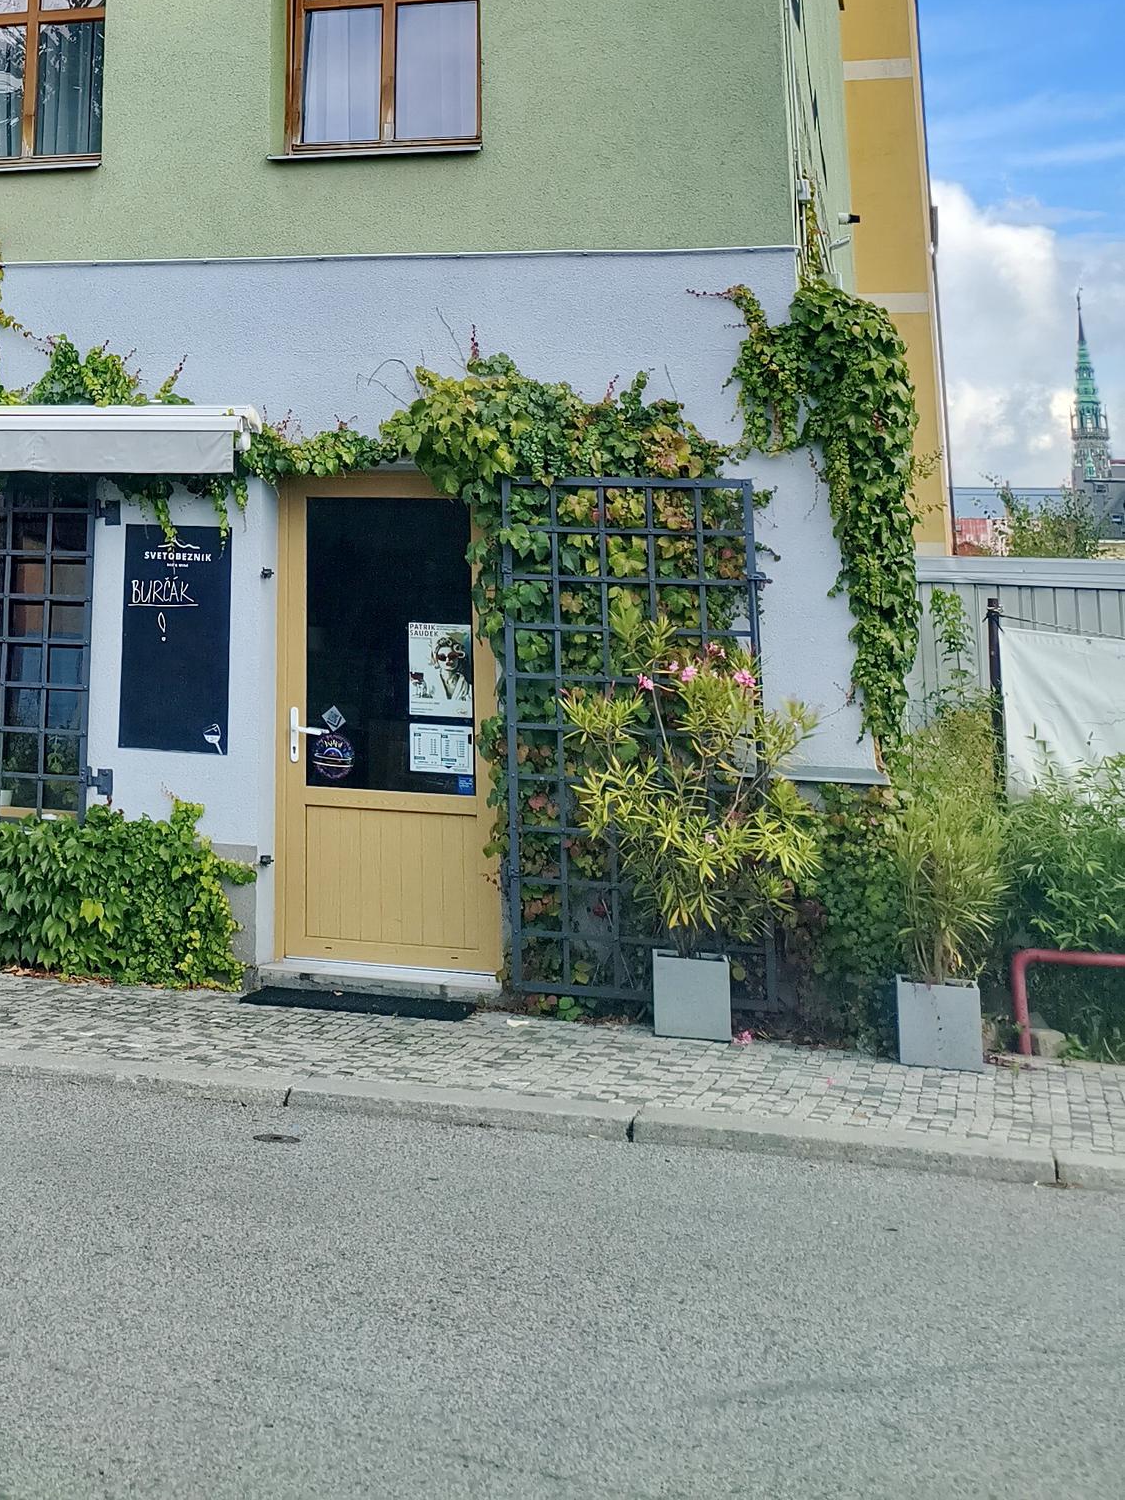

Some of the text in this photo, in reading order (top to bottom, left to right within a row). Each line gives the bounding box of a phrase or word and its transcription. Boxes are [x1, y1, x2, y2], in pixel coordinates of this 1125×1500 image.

[131, 576, 195, 604] BURČÁK
[410, 623, 436, 631] PATRIK
[410, 630, 439, 638] SAUDEK
